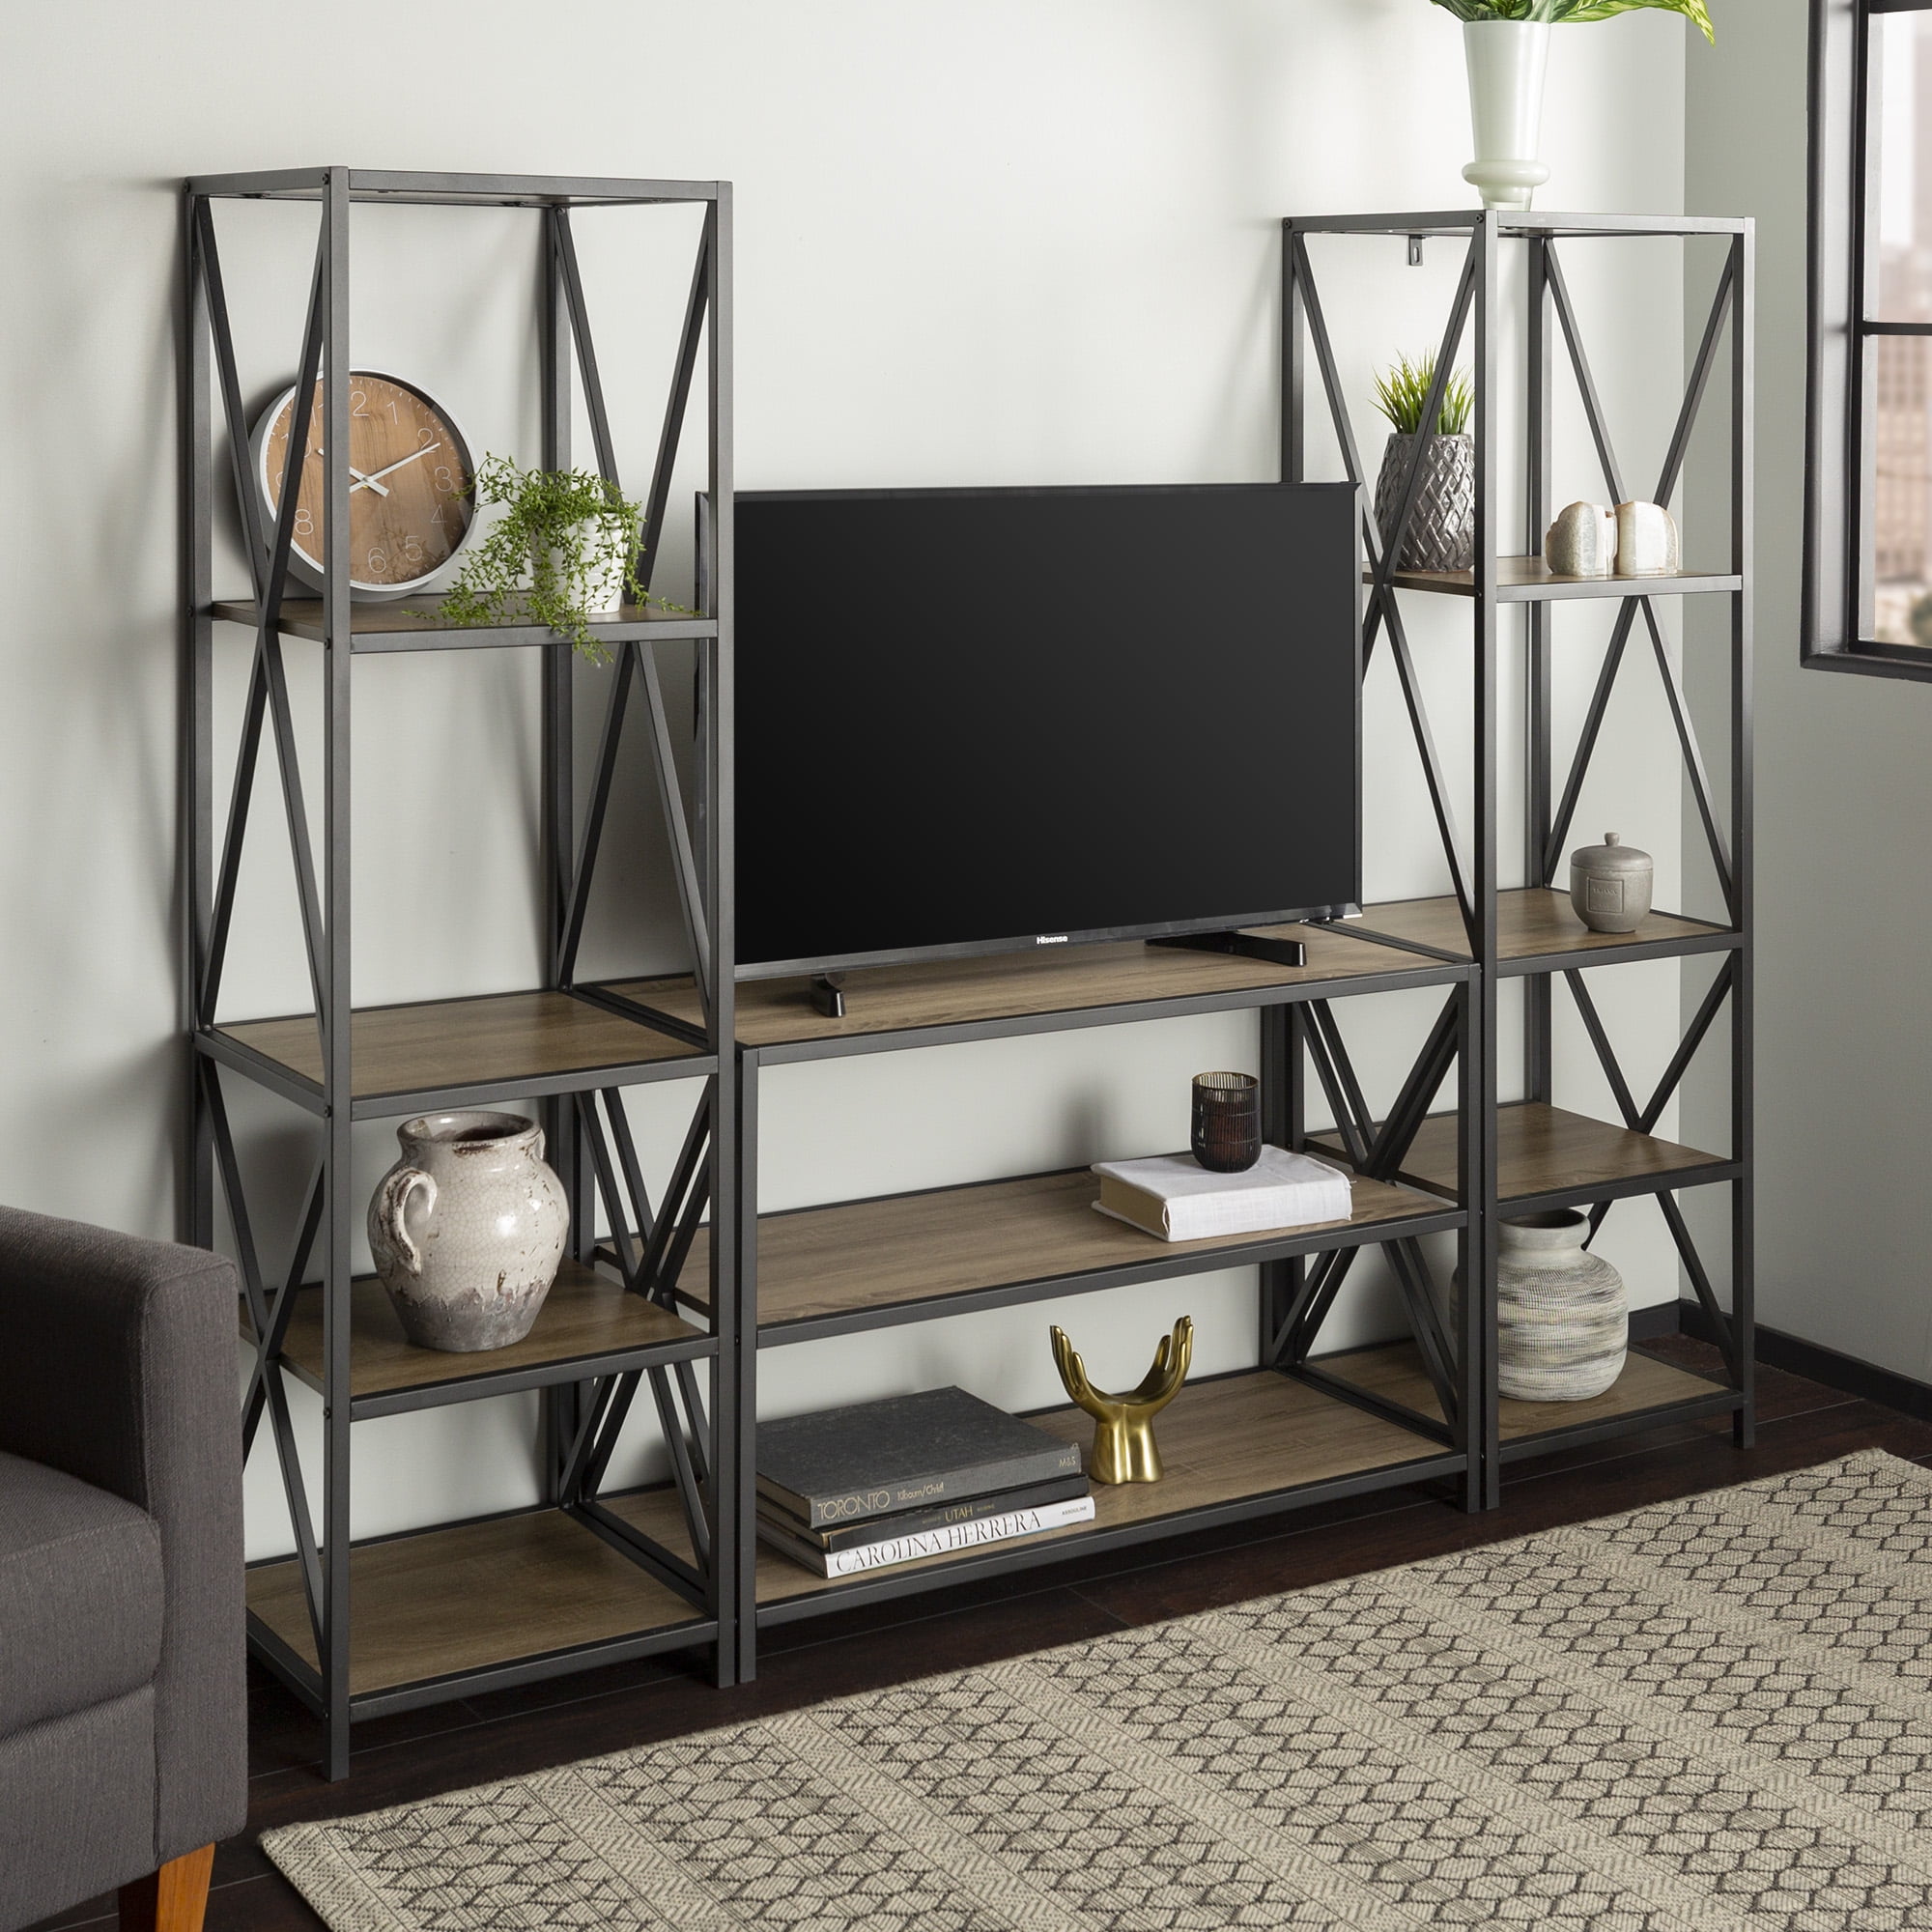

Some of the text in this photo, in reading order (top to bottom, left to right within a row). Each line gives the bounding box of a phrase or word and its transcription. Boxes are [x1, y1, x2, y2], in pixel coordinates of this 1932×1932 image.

[386, 401, 398, 425] 1
[417, 427, 437, 454] 2
[435, 466, 453, 492] 3
[295, 508, 314, 535] 8
[431, 504, 447, 527] 4
[367, 547, 387, 574] 6
[405, 535, 423, 562] 5
[1036, 935, 1068, 945] Hisense
[817, 1490, 891, 1520] TORONTO
[944, 1504, 974, 1523] UTAH
[837, 1511, 1041, 1573] CAROLINA HERRERA
